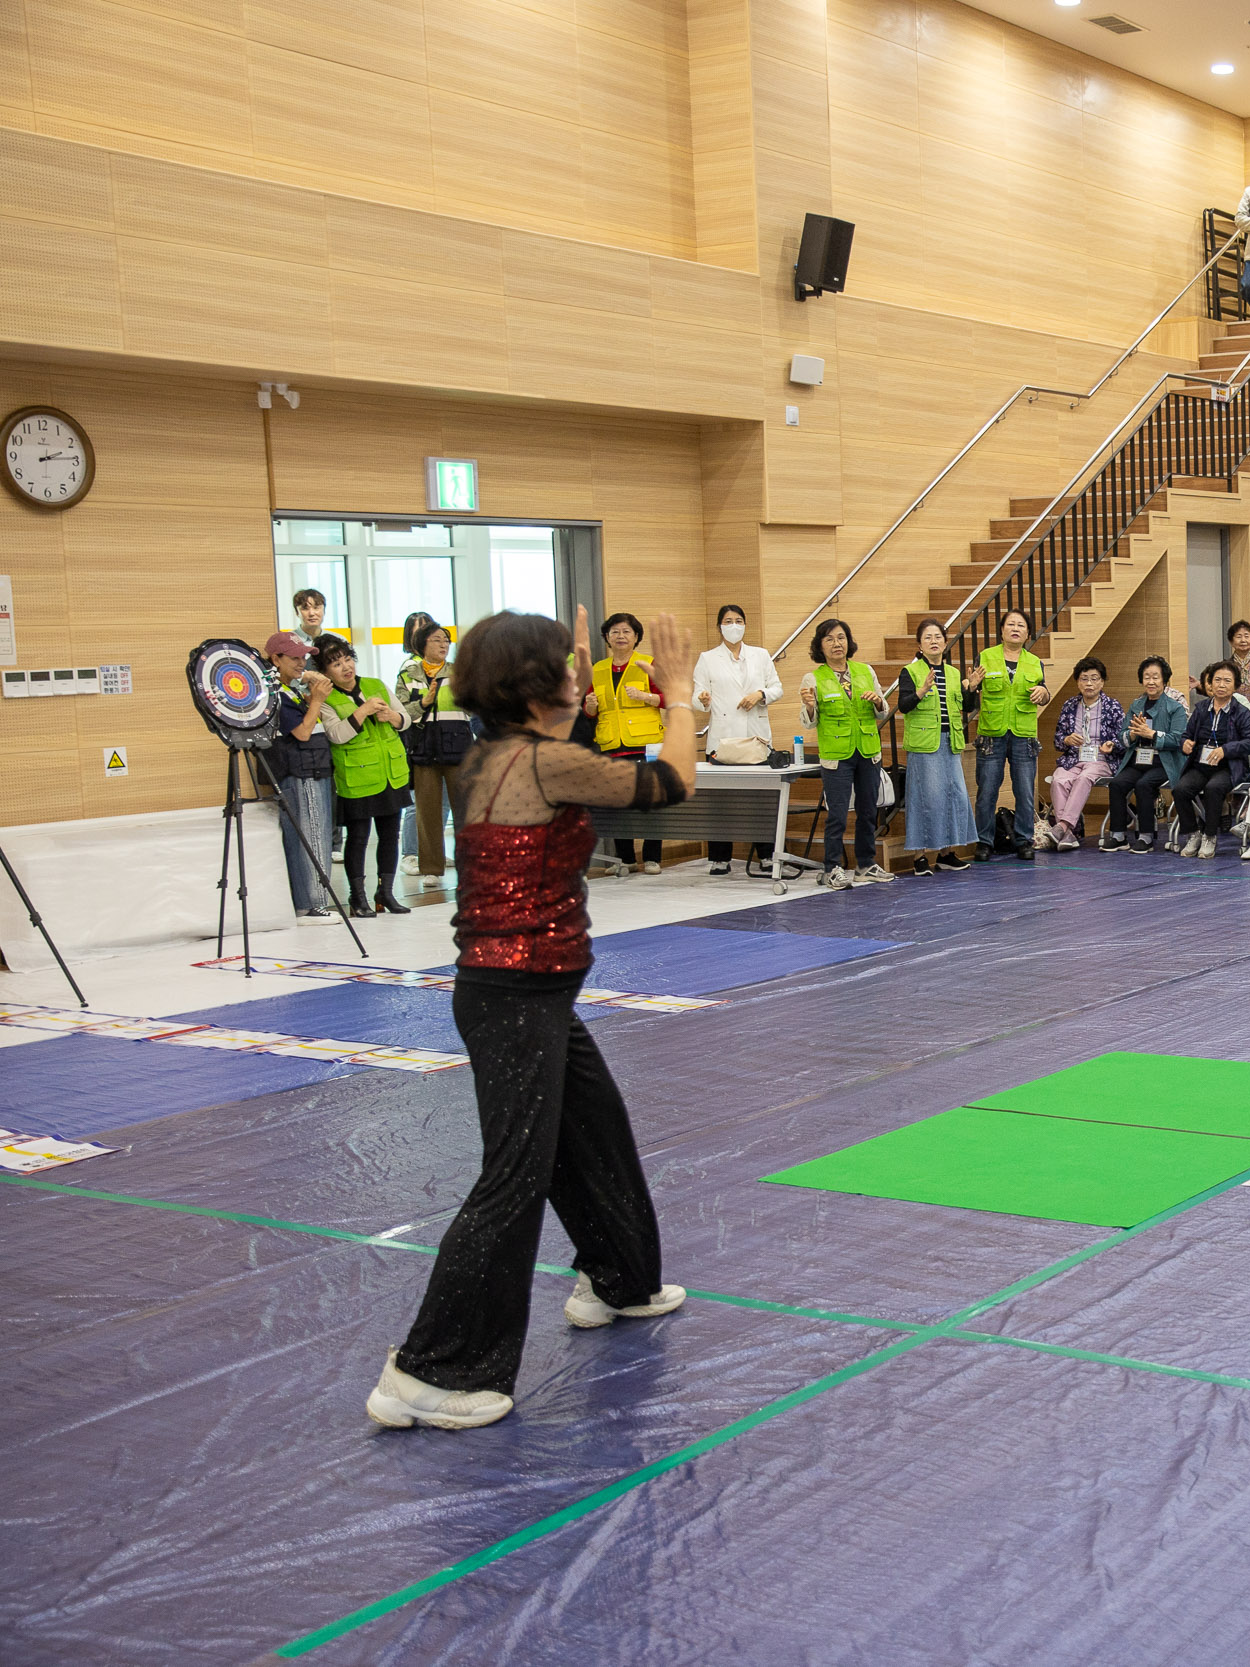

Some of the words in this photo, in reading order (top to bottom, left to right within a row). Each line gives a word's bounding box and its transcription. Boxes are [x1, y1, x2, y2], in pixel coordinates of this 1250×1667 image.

[23, 423, 31, 435] 11
[38, 420, 48, 431] 12
[12, 435, 23, 447] 10
[68, 437, 74, 448] 2
[10, 451, 17, 462] 9
[72, 455, 80, 467] 3
[15, 468, 23, 480] 8
[68, 471, 76, 482] 4
[28, 482, 34, 493] 7
[44, 487, 52, 498] 6
[59, 484, 67, 495] 5
